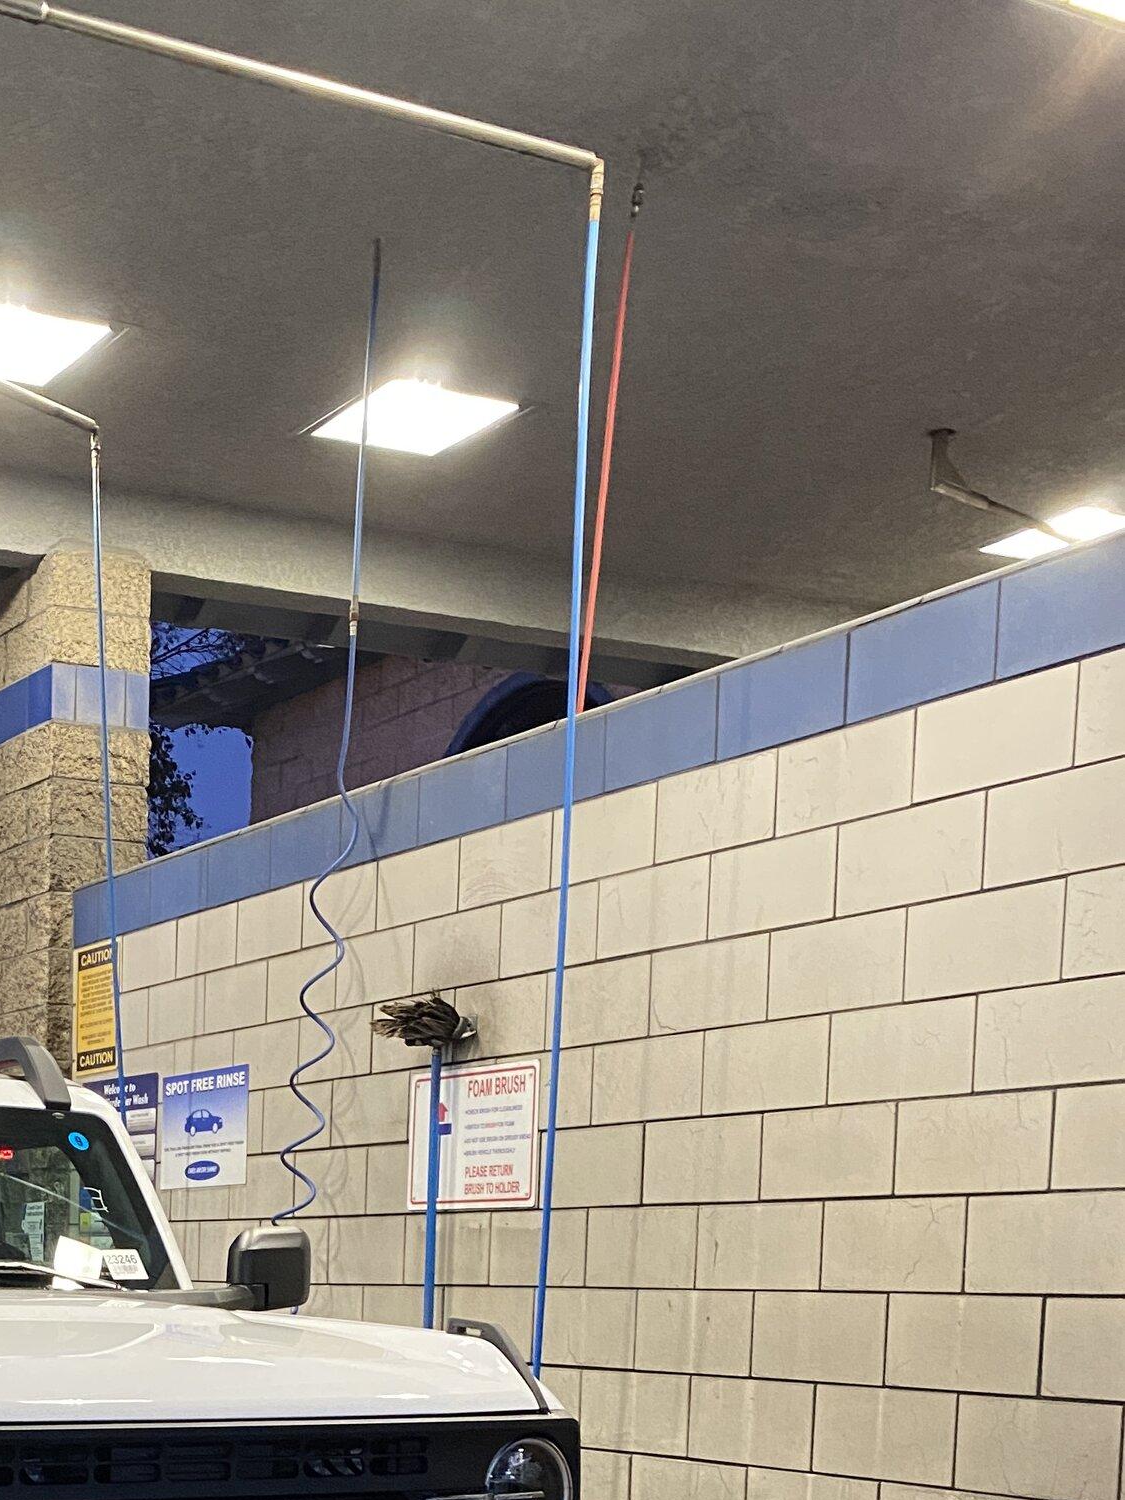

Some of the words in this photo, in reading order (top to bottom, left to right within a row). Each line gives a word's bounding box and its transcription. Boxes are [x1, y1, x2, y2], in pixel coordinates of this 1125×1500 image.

[80, 1051, 113, 1067] CAUTION
[103, 1083, 128, 1095] Welcoe
[128, 1082, 136, 1093] to
[166, 1080, 190, 1096] SPOT
[190, 1076, 215, 1093] FREE
[216, 1071, 246, 1089] RINSE
[467, 1078, 493, 1099] FOAM
[495, 1074, 526, 1095] BRUSH
[132, 1092, 149, 1105] Wash
[464, 1165, 487, 1178] PLEASE
[488, 1164, 513, 1176] RETURN
[464, 1183, 484, 1195] BRUSH
[486, 1182, 493, 1194] TO
[494, 1181, 520, 1194] HOLDER
